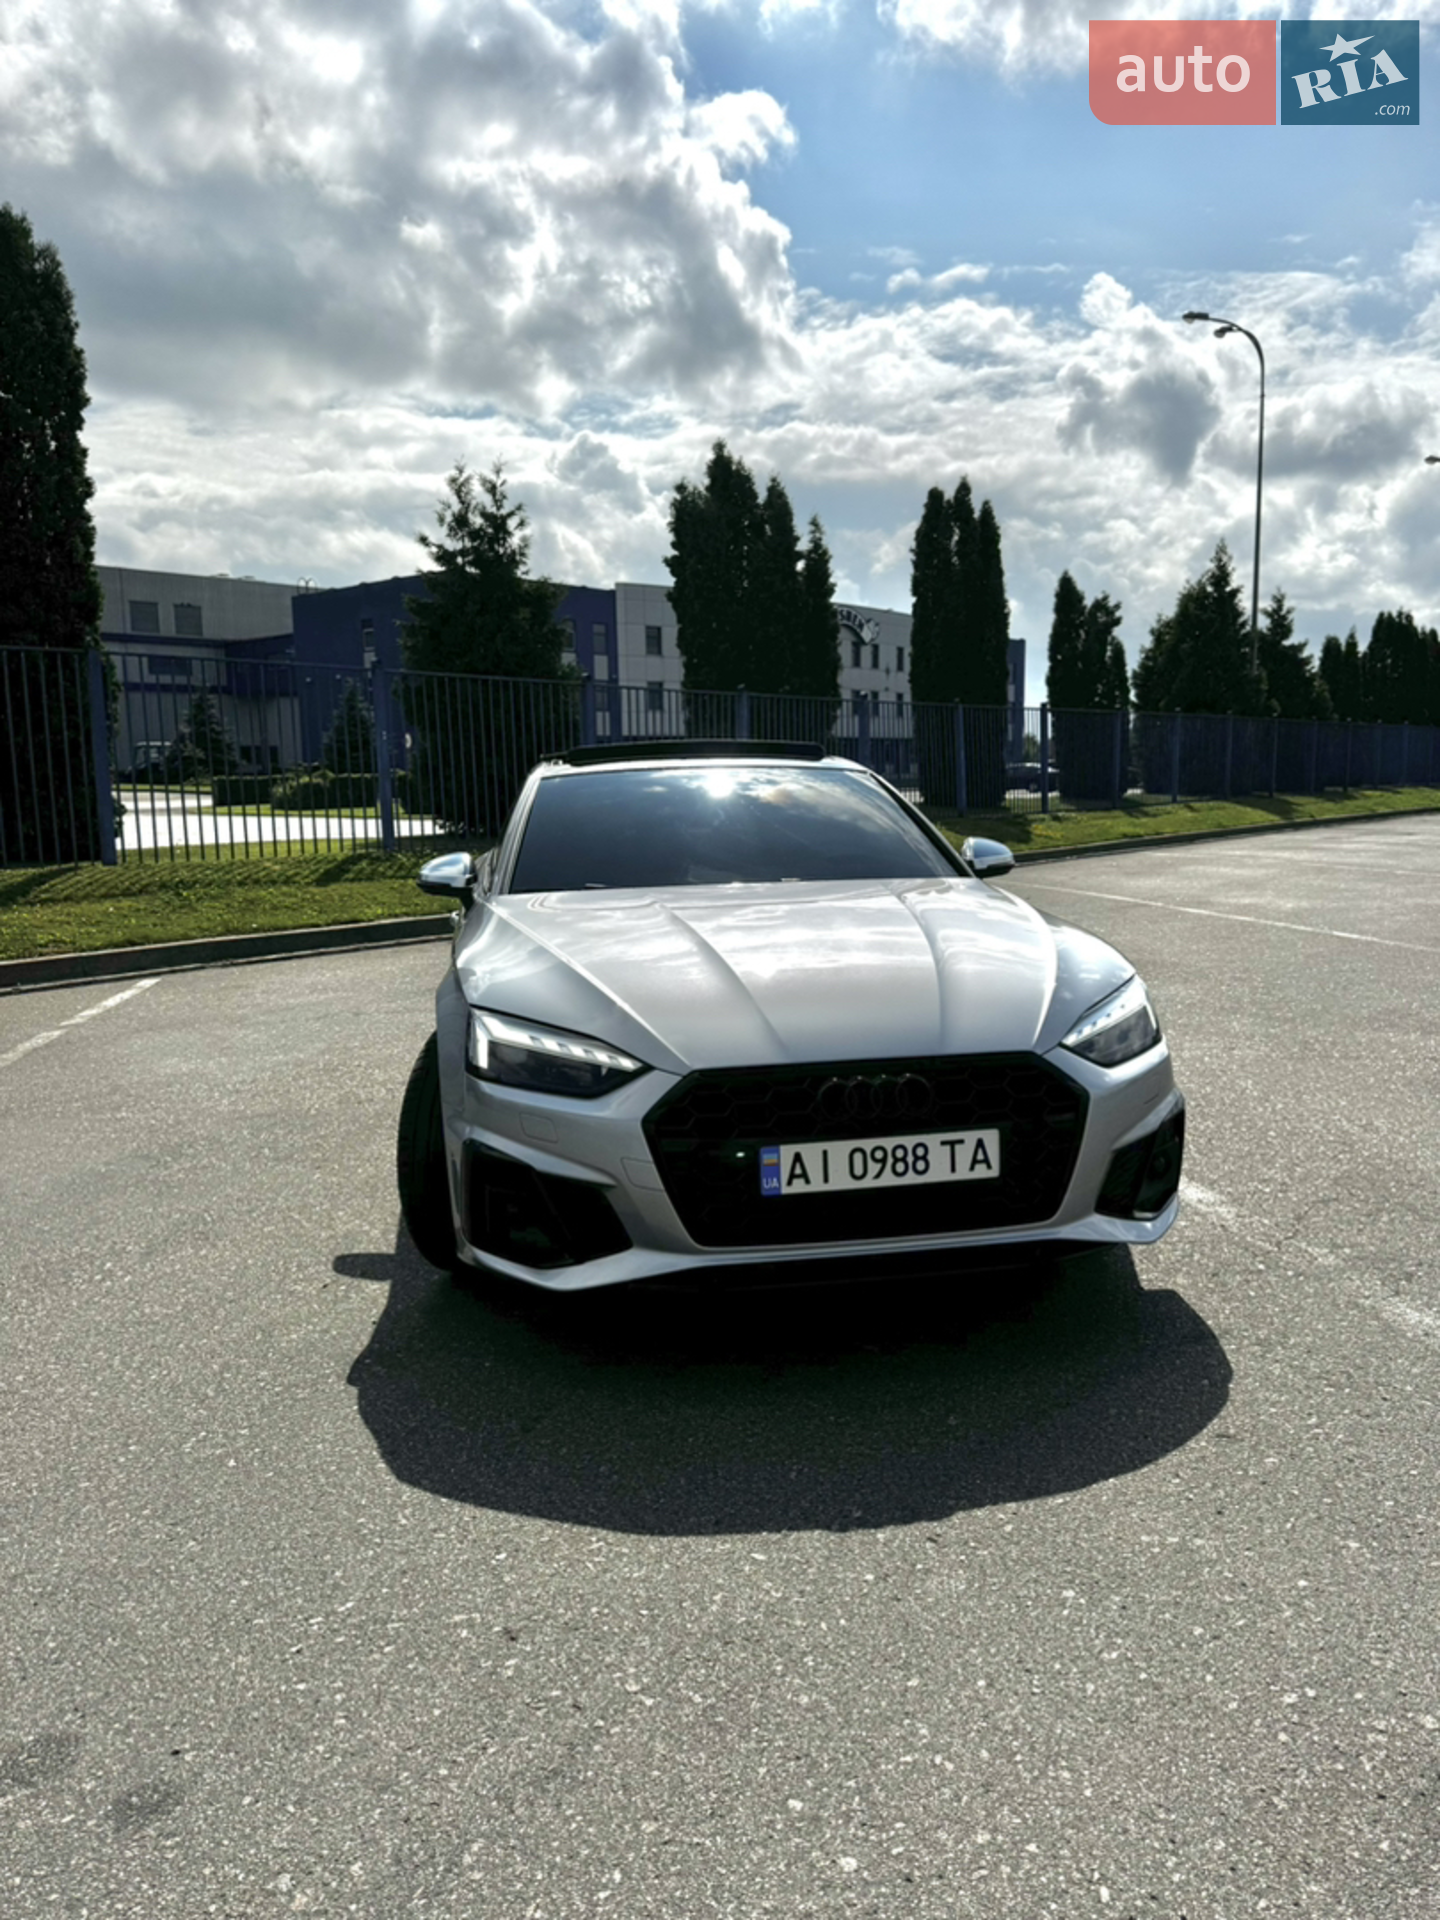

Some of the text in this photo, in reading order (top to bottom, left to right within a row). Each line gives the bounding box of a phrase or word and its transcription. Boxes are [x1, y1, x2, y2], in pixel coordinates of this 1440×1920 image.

[786, 1137, 992, 1186] AI 0988 TA
[763, 1177, 779, 1188] UA
